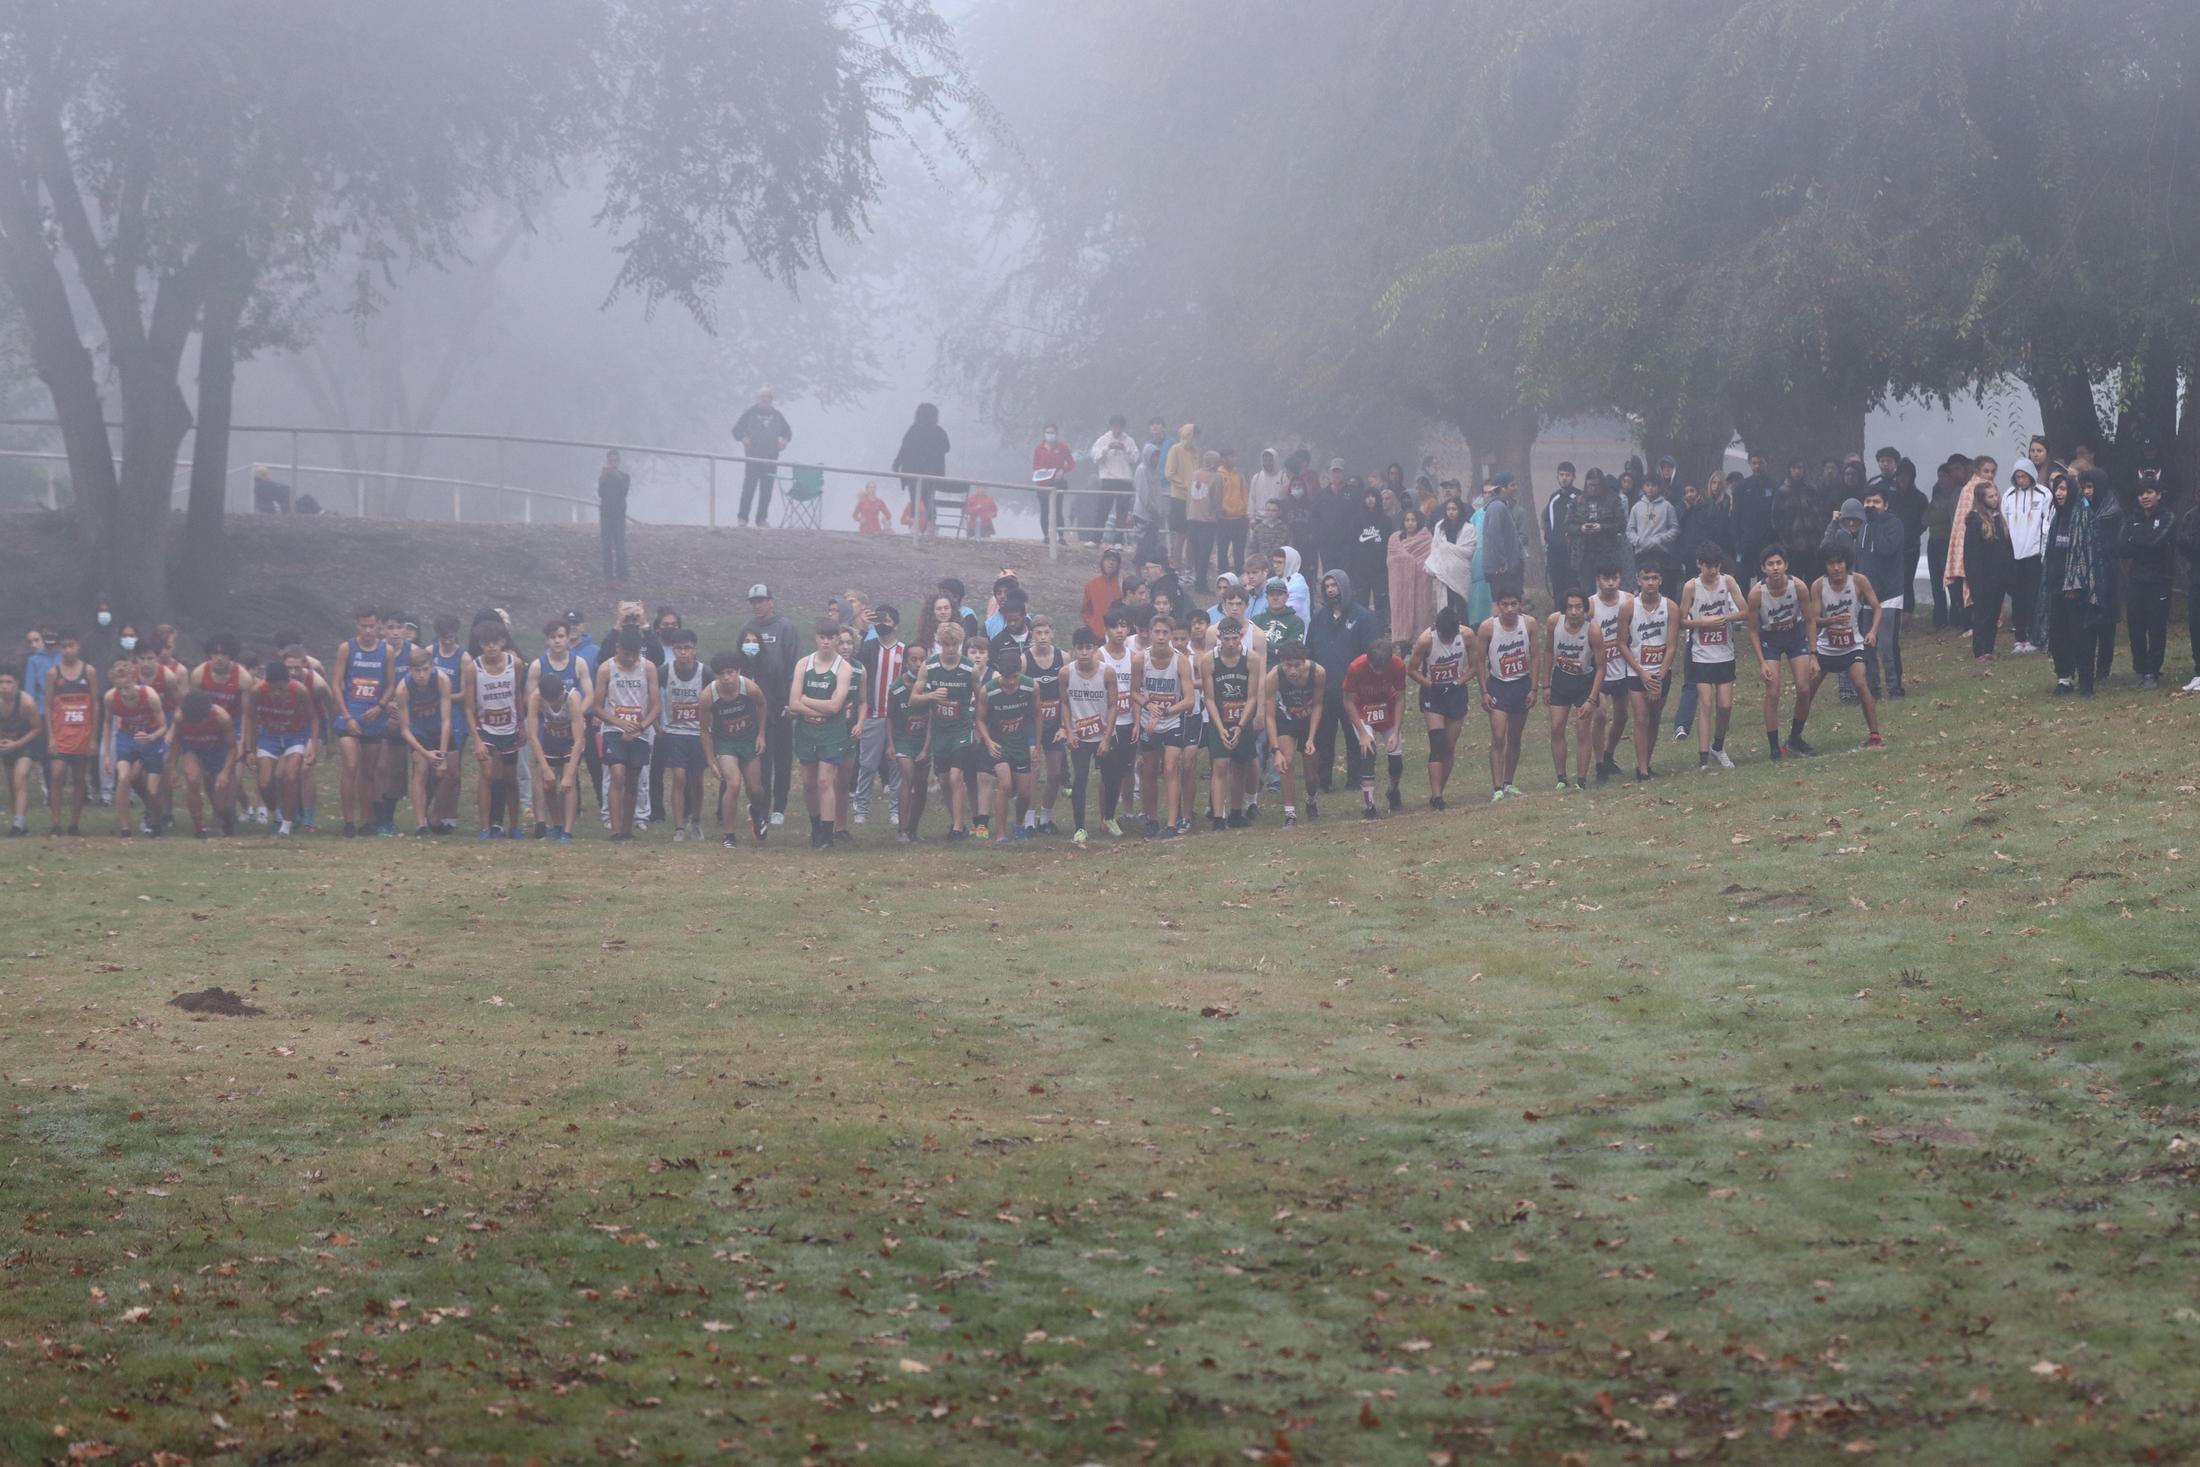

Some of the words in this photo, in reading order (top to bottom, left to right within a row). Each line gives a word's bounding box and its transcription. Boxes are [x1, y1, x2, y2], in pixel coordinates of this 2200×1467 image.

[1637, 621, 1664, 632] Madera
[1703, 631, 1722, 643] 725
[1832, 635, 1849, 645] 719
[1497, 640, 1525, 653] Madera
[1645, 652, 1662, 663] 726
[1505, 661, 1523, 674] 716
[1434, 670, 1453, 681] 721
[483, 681, 511, 691] TULARE
[616, 680, 642, 689] AZTECS
[482, 691, 513, 701] WESTERN
[671, 687, 698, 698] AZTECS
[1068, 689, 1104, 699] REDWOOD
[676, 709, 696, 720] 792
[1079, 723, 1100, 737] 738
